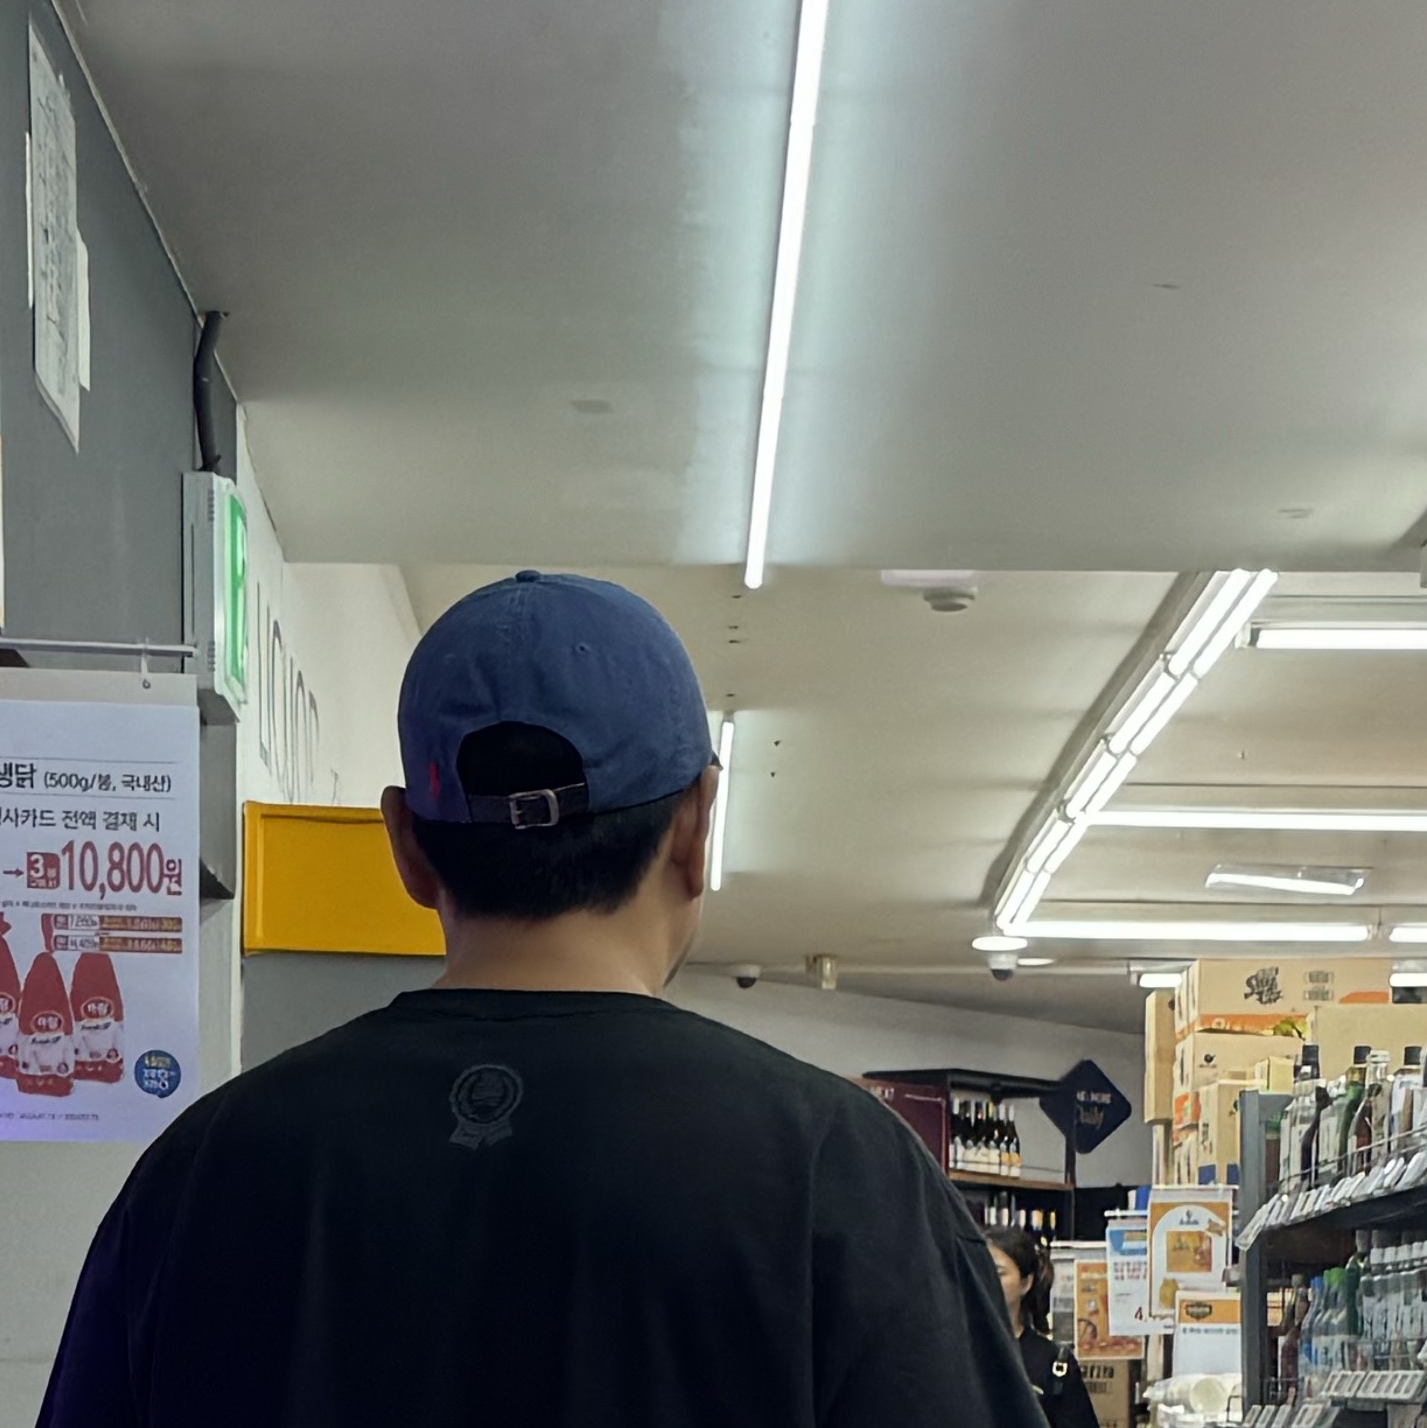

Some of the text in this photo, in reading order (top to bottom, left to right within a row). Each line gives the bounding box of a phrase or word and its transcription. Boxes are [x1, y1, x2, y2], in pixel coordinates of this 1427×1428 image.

[121, 774, 172, 793] 국내산)
[62, 809, 97, 831] 전액
[143, 812, 161, 832] 시
[62, 840, 183, 900] 10,800원
